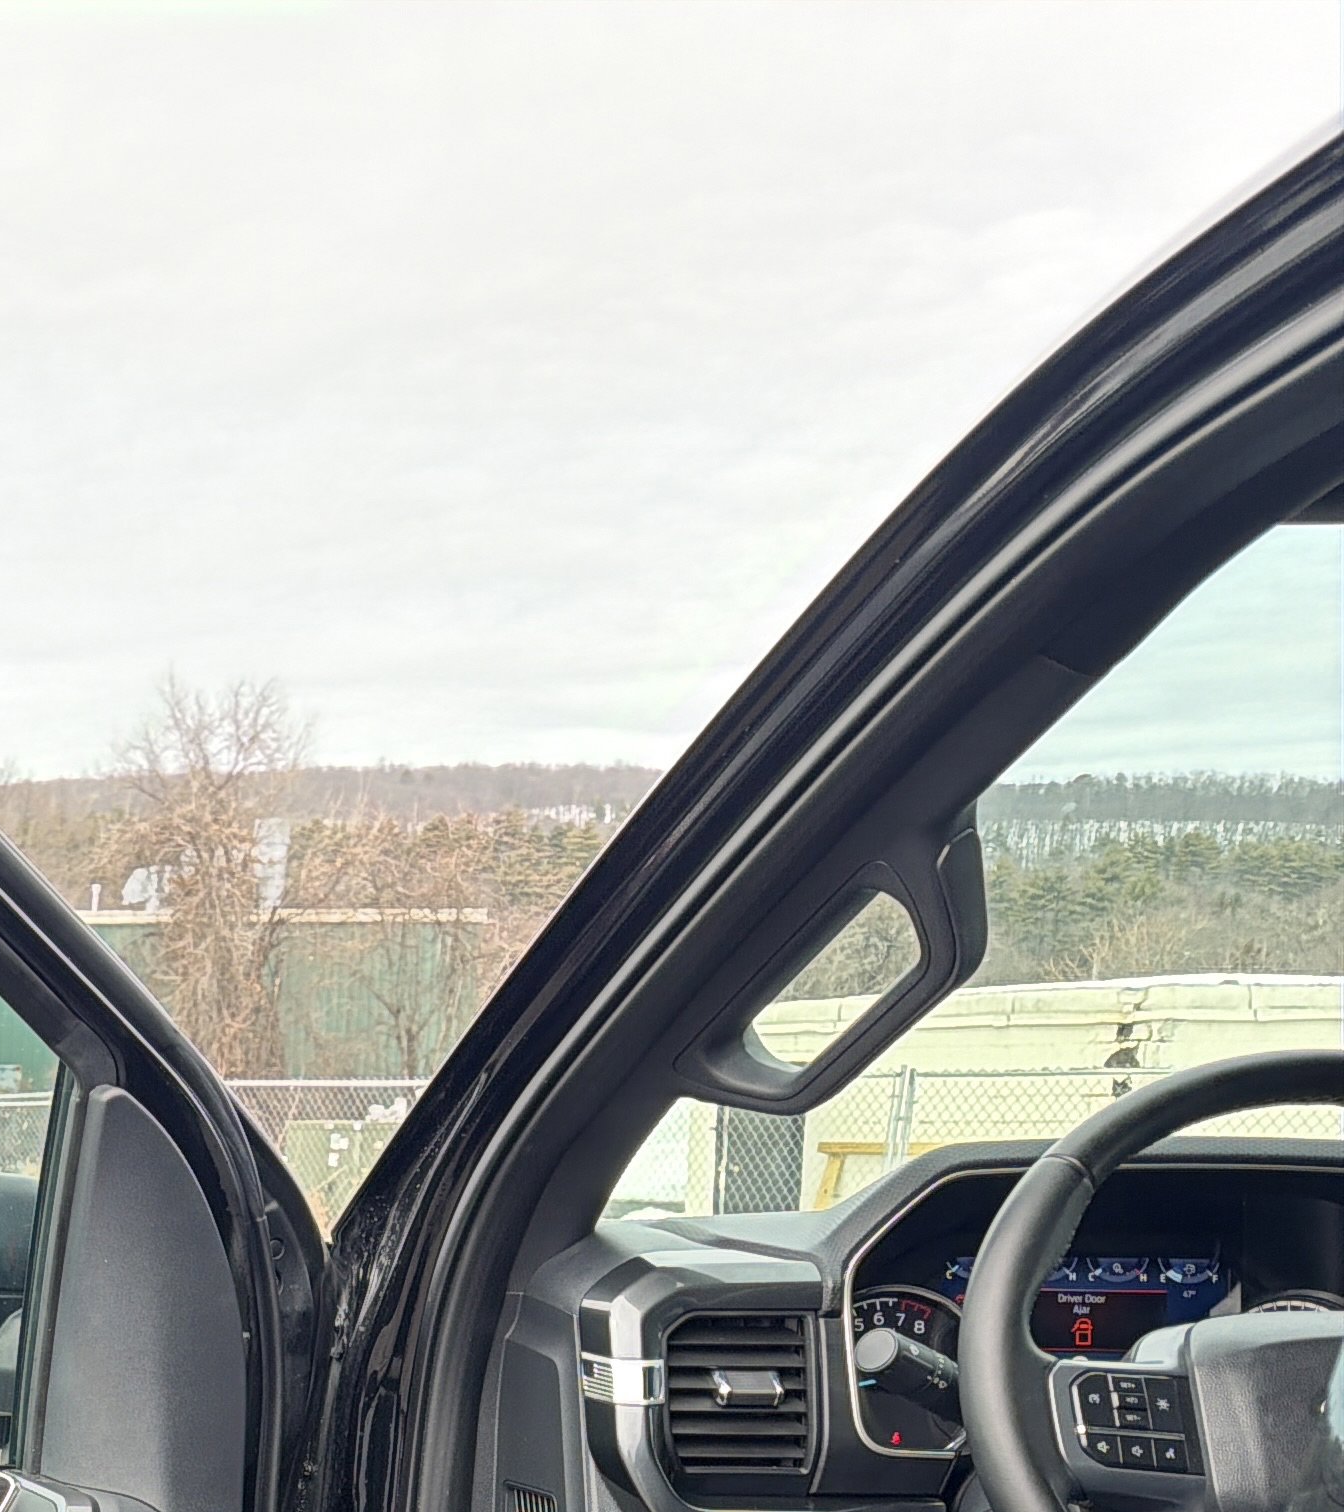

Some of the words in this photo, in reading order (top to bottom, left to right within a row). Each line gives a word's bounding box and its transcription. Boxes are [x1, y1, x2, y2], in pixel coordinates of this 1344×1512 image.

[1068, 1273, 1077, 1282] H
[1140, 1274, 1148, 1282] H
[1159, 1274, 1167, 1283] E
[1212, 1274, 1219, 1283] F
[1057, 1293, 1083, 1304] Driver
[1084, 1294, 1107, 1304] Door
[1072, 1304, 1091, 1315] Ajar
[873, 1311, 885, 1326] 6
[895, 1312, 906, 1327] 7
[854, 1318, 865, 1332] 5
[913, 1320, 926, 1334] 8
